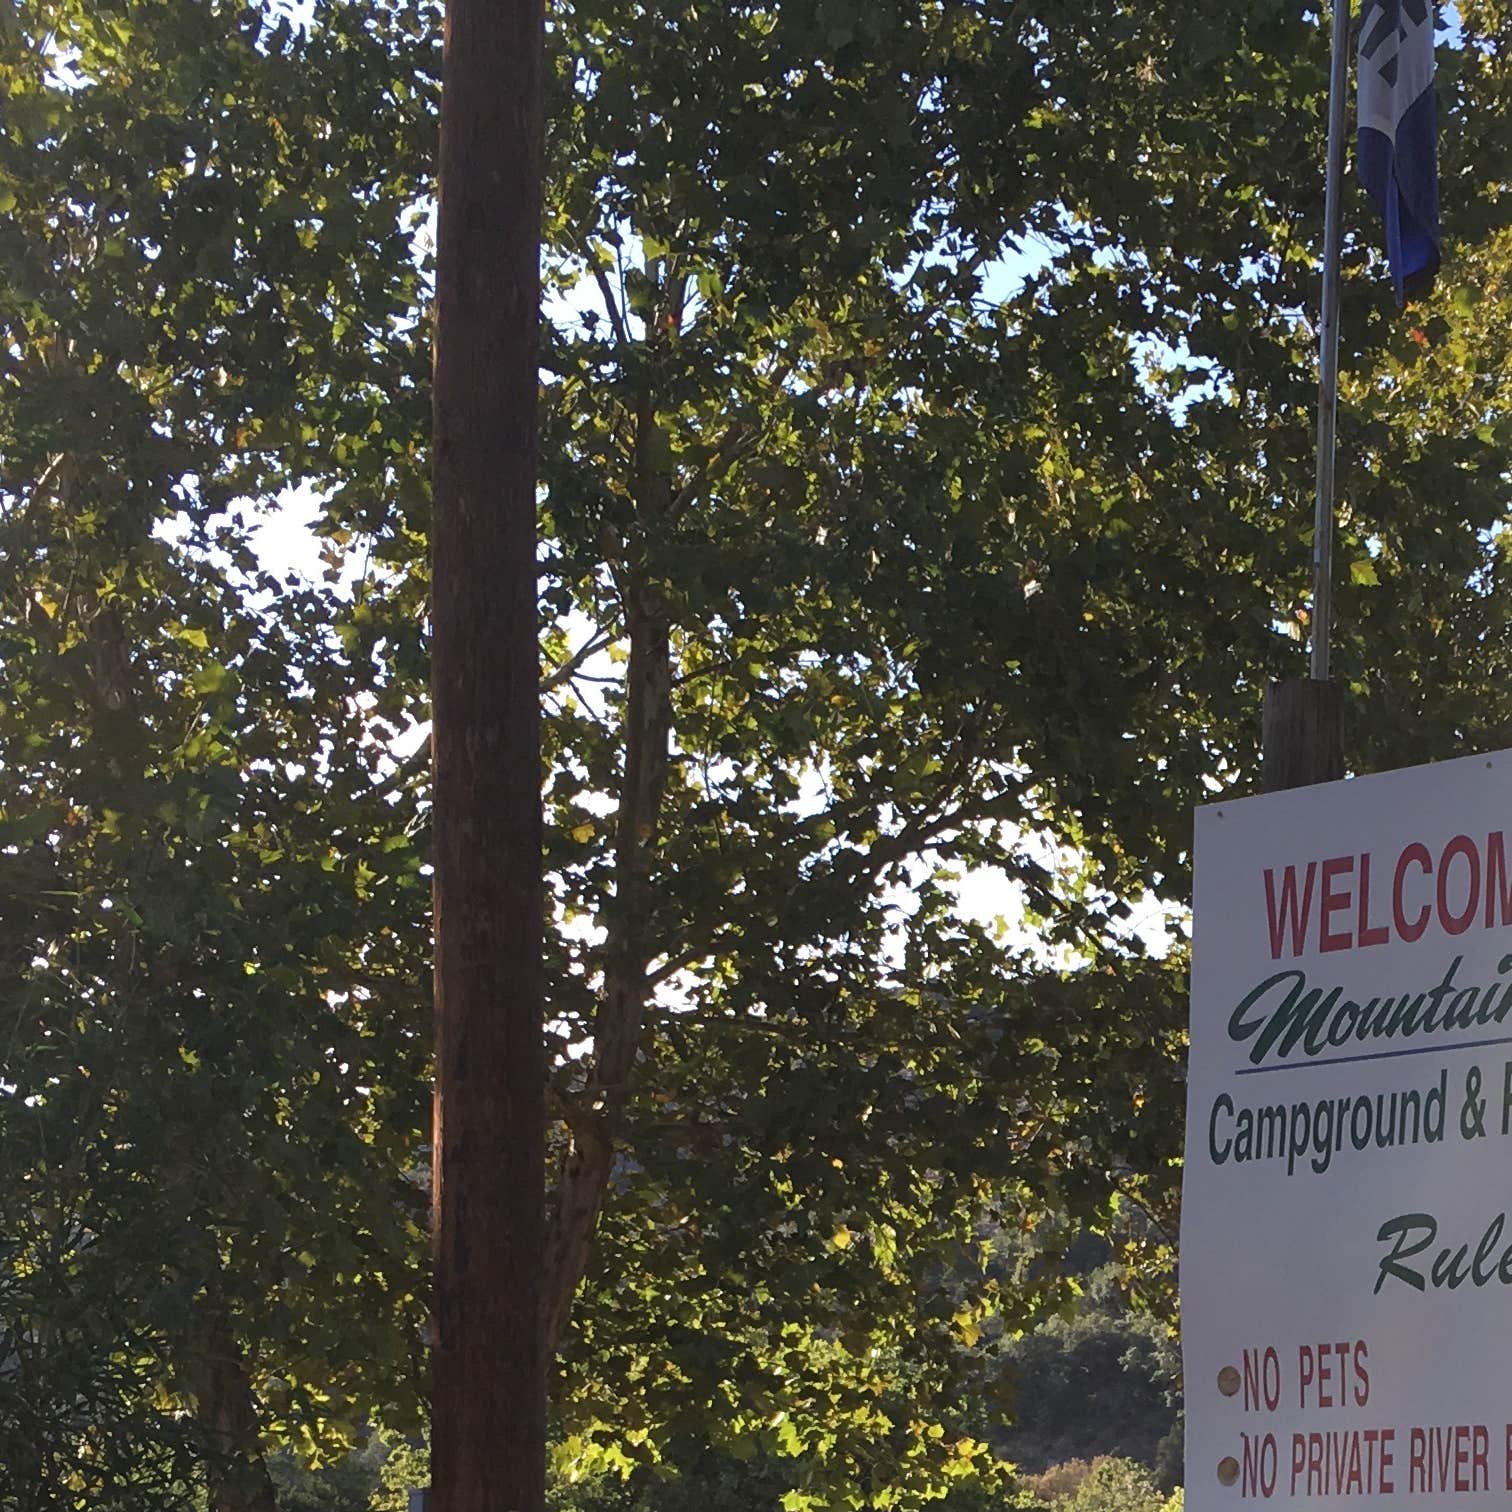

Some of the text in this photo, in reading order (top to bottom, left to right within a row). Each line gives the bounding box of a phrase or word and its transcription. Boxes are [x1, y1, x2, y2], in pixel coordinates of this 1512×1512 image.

[1209, 1069, 1447, 1176] Campground
[1460, 1066, 1486, 1140] &
[1243, 1340, 1369, 1412] NO PETS
[1240, 1432, 1277, 1498] NO
[1290, 1429, 1395, 1496] PRIVATE
[1409, 1425, 1489, 1493] RIVER
